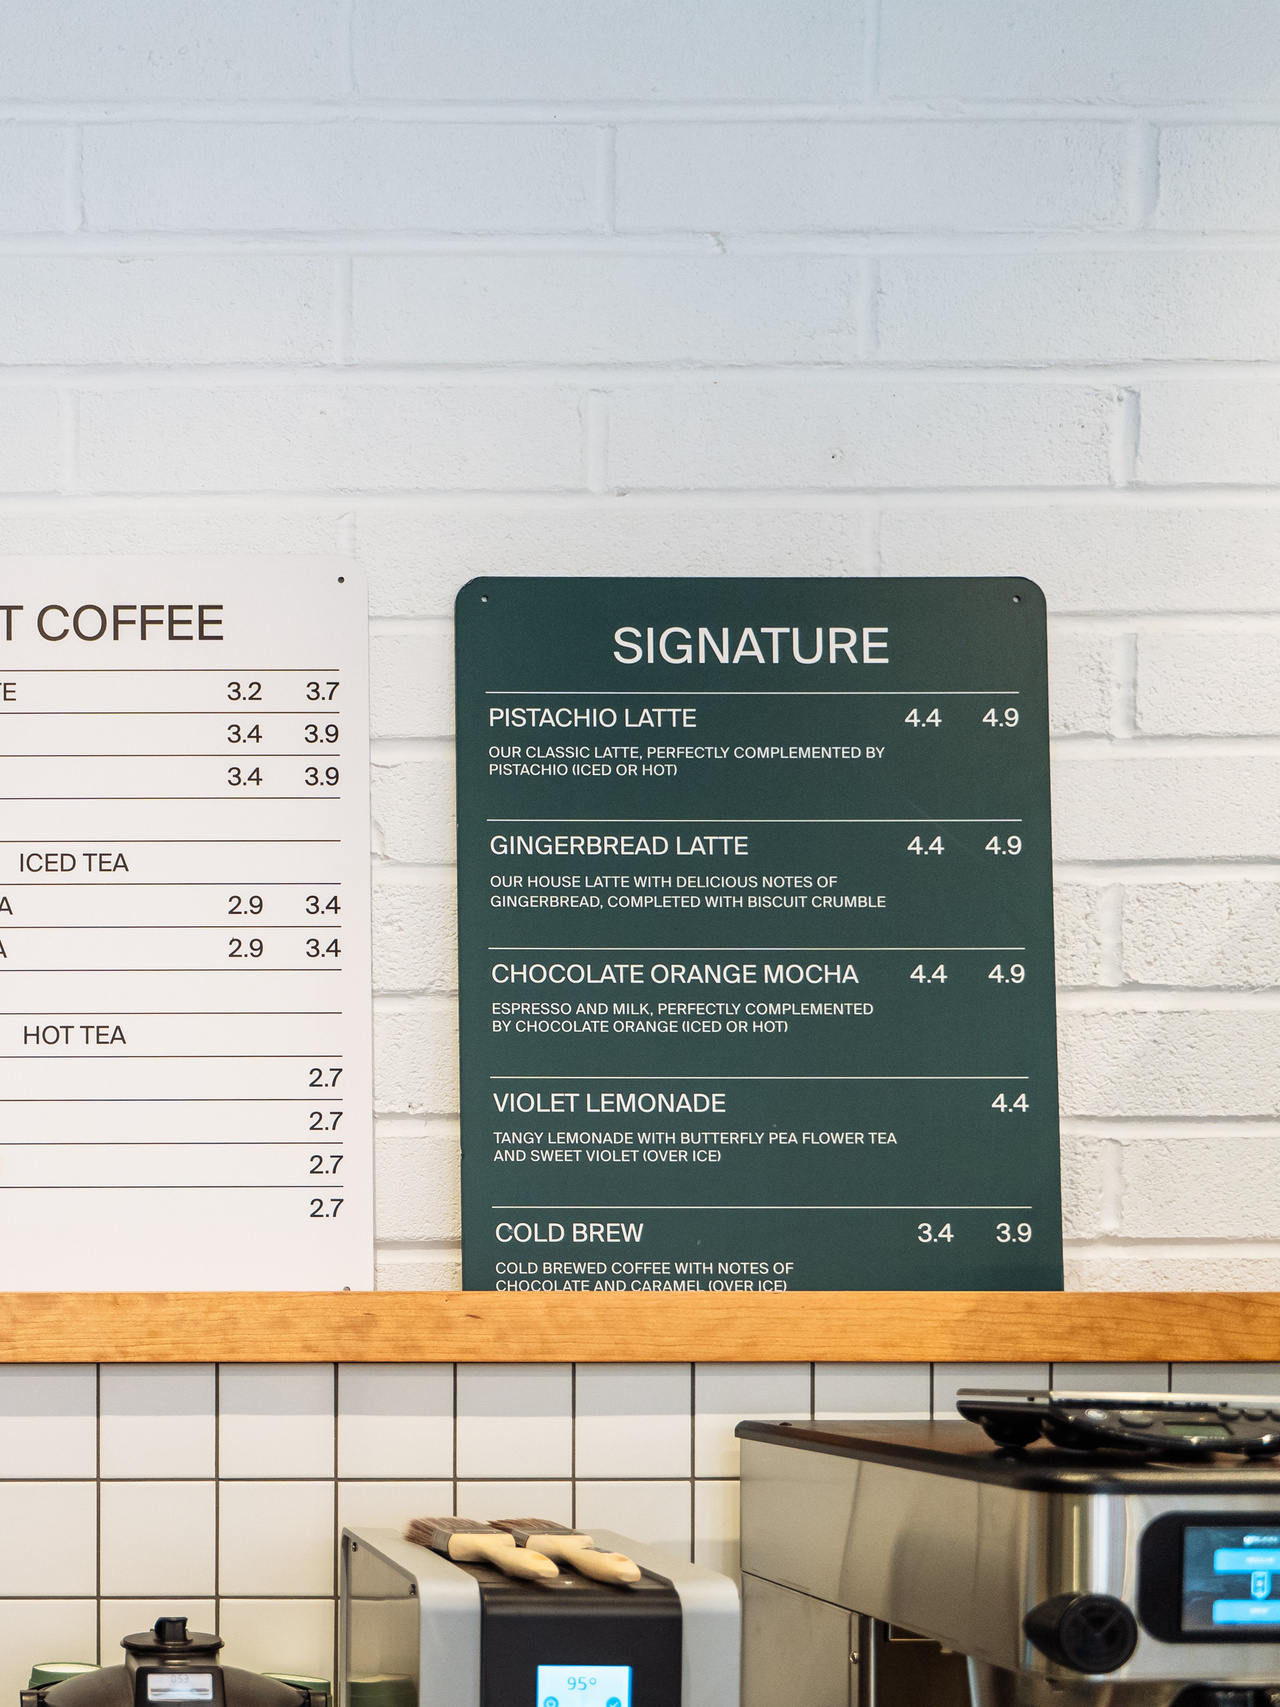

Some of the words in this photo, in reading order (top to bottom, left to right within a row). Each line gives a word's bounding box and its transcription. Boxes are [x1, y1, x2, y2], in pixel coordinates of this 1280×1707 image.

[36, 604, 224, 642] COFFEE
[613, 626, 890, 665] SIGNATURE
[226, 681, 263, 702] 3.2
[305, 681, 340, 701] 3.7
[489, 707, 618, 728] PISTACHIO
[624, 708, 697, 728] LATTE
[904, 707, 943, 728] 4.4
[981, 707, 1020, 728] 4.9
[227, 723, 263, 744] 3.4
[304, 723, 340, 744] 3.9
[488, 745, 522, 759] OUR
[525, 745, 591, 759] CLASSIC
[594, 746, 643, 761] LATTE,
[647, 746, 730, 759] PERFECTLY
[733, 746, 862, 759] COMPLEMENTED
[865, 746, 886, 759] BY
[227, 766, 264, 787] 3.4
[304, 766, 340, 787] 3.9
[489, 763, 569, 776] PISTACHIO
[571, 763, 612, 777] (ICED
[615, 763, 638, 777] OR
[642, 763, 678, 777] HOT)
[490, 835, 669, 856] GINGERBREAD
[676, 835, 749, 856] LATTE
[906, 835, 945, 856] 4.4
[984, 835, 1023, 856] 4.9
[19, 852, 77, 873] ICED
[82, 852, 130, 873] TEA
[489, 875, 524, 888] OUR
[527, 875, 581, 888] HOUSE
[584, 875, 630, 888] LATTE
[633, 875, 672, 888] WITH
[676, 875, 759, 889] DELICIOUS
[762, 875, 813, 889] NOTES
[816, 875, 838, 889] OF
[227, 894, 264, 915] 2.9
[305, 894, 342, 915] 3.4
[490, 895, 604, 910] GINGERBREAD,
[607, 895, 701, 908] COMPLETED
[704, 895, 744, 908] WITH
[747, 895, 808, 909] BISCUIT
[811, 895, 887, 909] CRUMBLE
[228, 936, 264, 959] 2.9
[305, 937, 342, 958] 3.4
[491, 963, 645, 984] CHOCOLATE
[650, 963, 758, 984] ORANGE
[763, 963, 860, 984] MOCHA
[909, 963, 948, 984] 4.4
[987, 963, 1026, 984] 4.9
[492, 1002, 572, 1016] ESPRESSO
[575, 1002, 609, 1015] AND
[612, 1002, 654, 1017] MILK,
[657, 1002, 742, 1016] PERFECTLY
[744, 1002, 874, 1016] COMPLEMENTED
[23, 1025, 75, 1045] HOT
[79, 1025, 127, 1045] TEA
[492, 1019, 512, 1033] BY
[515, 1019, 610, 1033] CHOCOLATE
[612, 1020, 679, 1033] ORANGE
[681, 1020, 722, 1033] (ICED
[725, 1020, 749, 1033] OR
[752, 1020, 789, 1033] HOT)
[308, 1067, 344, 1088] 2.7
[492, 1092, 581, 1113] VIOLET
[586, 1092, 727, 1113] LEMONADE
[991, 1092, 1030, 1113] 4.4
[308, 1110, 344, 1131] 2.7
[492, 1131, 544, 1145] TANGY
[547, 1131, 634, 1145] LEMONADE
[636, 1131, 676, 1145] WITH
[680, 1131, 765, 1145] BUTTERFLY
[768, 1131, 799, 1145] PEA
[802, 1131, 865, 1145] FLOWER
[867, 1131, 898, 1145] TEA
[309, 1154, 344, 1175] 2.7
[309, 1197, 345, 1218] 2.7
[495, 1222, 565, 1243] COLD
[572, 1222, 644, 1243] BREW
[917, 1222, 955, 1243] 3.4
[995, 1222, 1033, 1243] 3.9
[495, 1261, 539, 1275] COLD
[542, 1261, 608, 1275] BREWED
[611, 1261, 671, 1275] COFFEE
[674, 1261, 714, 1275] WITH
[717, 1261, 770, 1275] NOTES
[772, 1261, 795, 1275] OF
[567, 1676, 597, 1691] 95°
